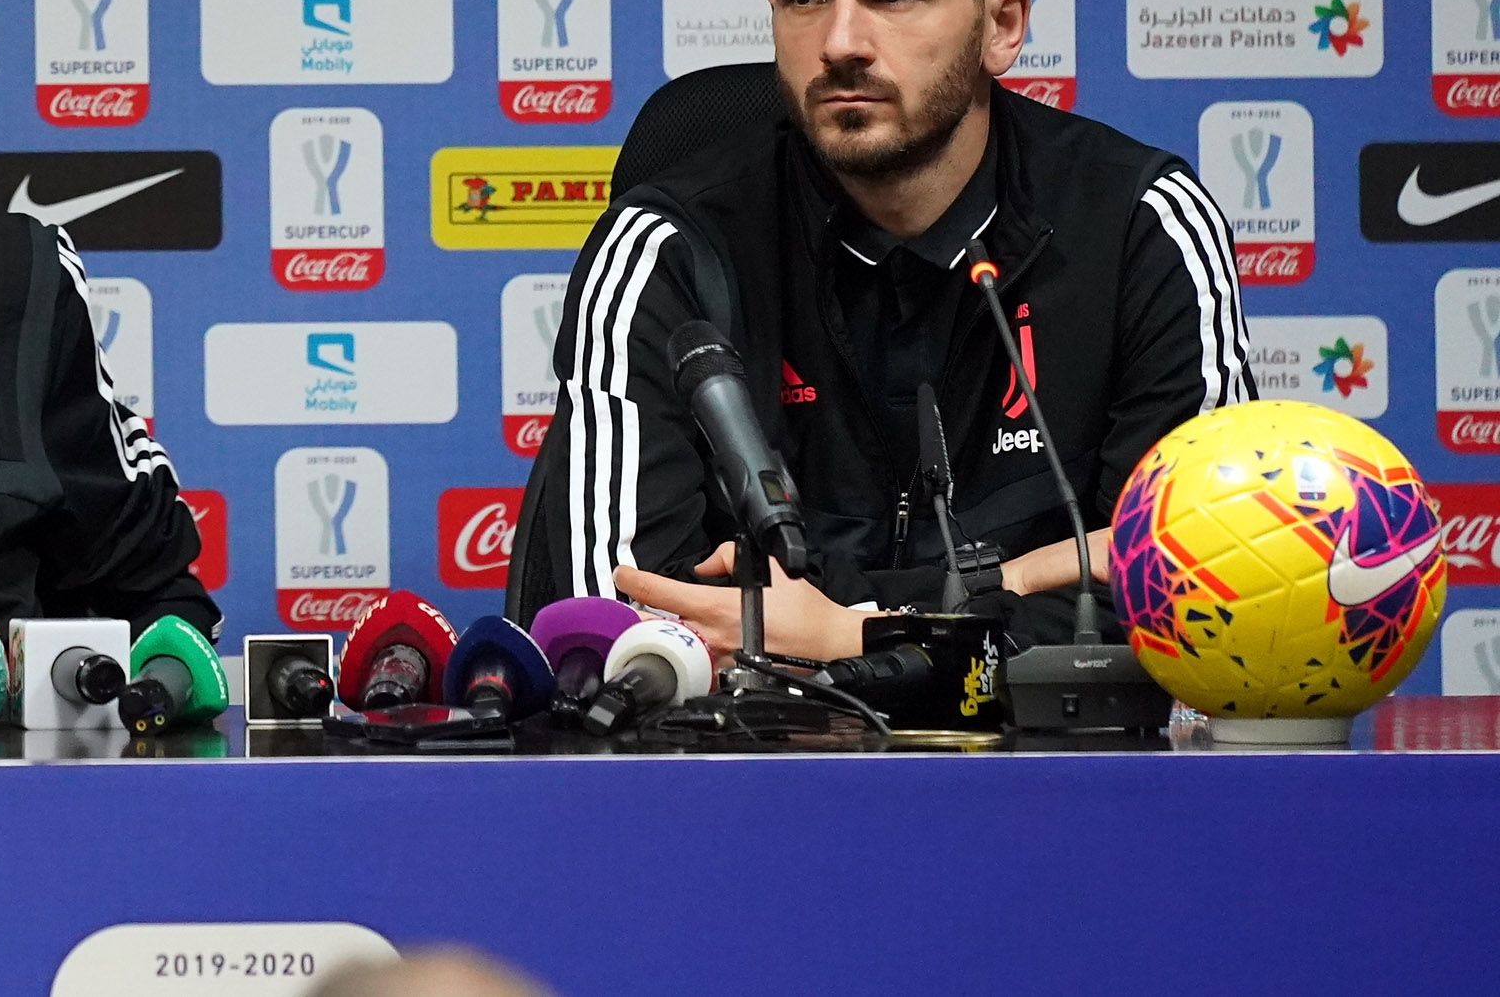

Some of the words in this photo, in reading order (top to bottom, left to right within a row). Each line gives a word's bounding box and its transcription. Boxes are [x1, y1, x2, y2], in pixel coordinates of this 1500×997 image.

[703, 34, 776, 48] SULAIMA
[1140, 31, 1222, 48] Jazeera
[1230, 30, 1295, 47] Paints
[301, 58, 352, 72] Mobily
[512, 58, 597, 71] SUPERCUP
[1446, 51, 1500, 66] SUPER
[50, 61, 135, 74] SUPERCUP
[511, 181, 607, 202] PANI
[284, 225, 370, 239] SUPERCUP
[1231, 219, 1300, 233] UPERCUP
[1254, 370, 1300, 389] ints
[517, 392, 557, 406] SUPE
[291, 566, 375, 578] SUPERCUP
[658, 623, 695, 649] 24
[155, 953, 317, 979] 2019-2020
